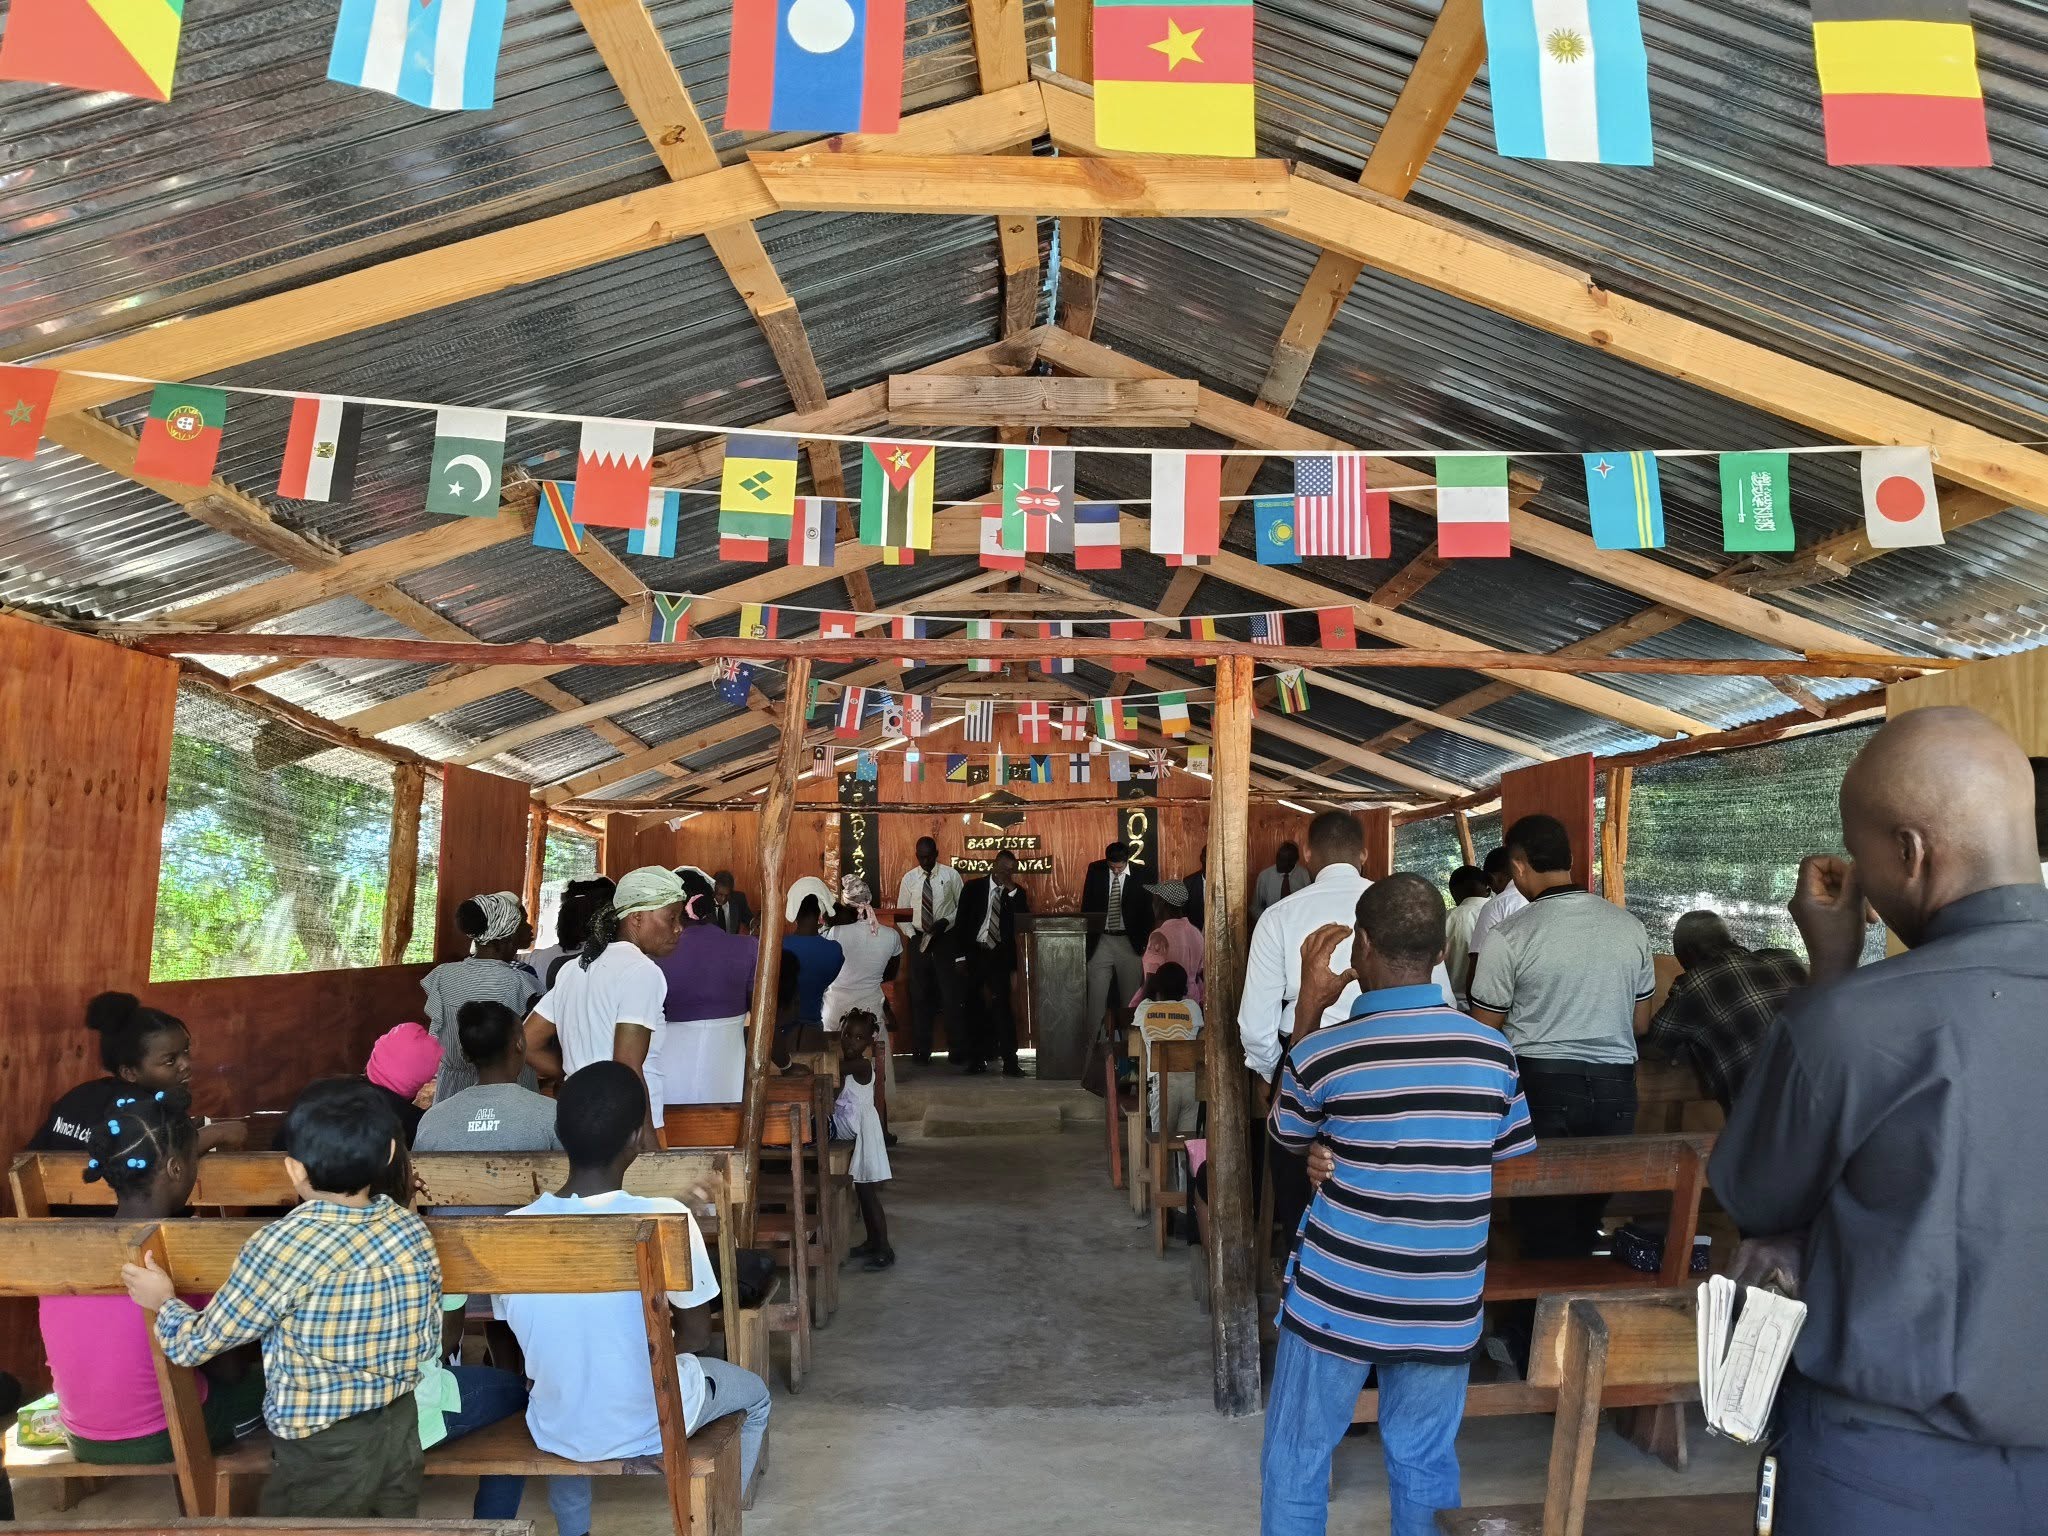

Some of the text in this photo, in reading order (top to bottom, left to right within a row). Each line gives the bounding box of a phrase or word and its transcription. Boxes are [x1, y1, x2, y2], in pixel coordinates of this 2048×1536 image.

[967, 836, 1036, 849] BAPTISTE
[951, 856, 1052, 872] FONDANTAL
[475, 1108, 496, 1120] ALL
[468, 1120, 500, 1131] HEART
